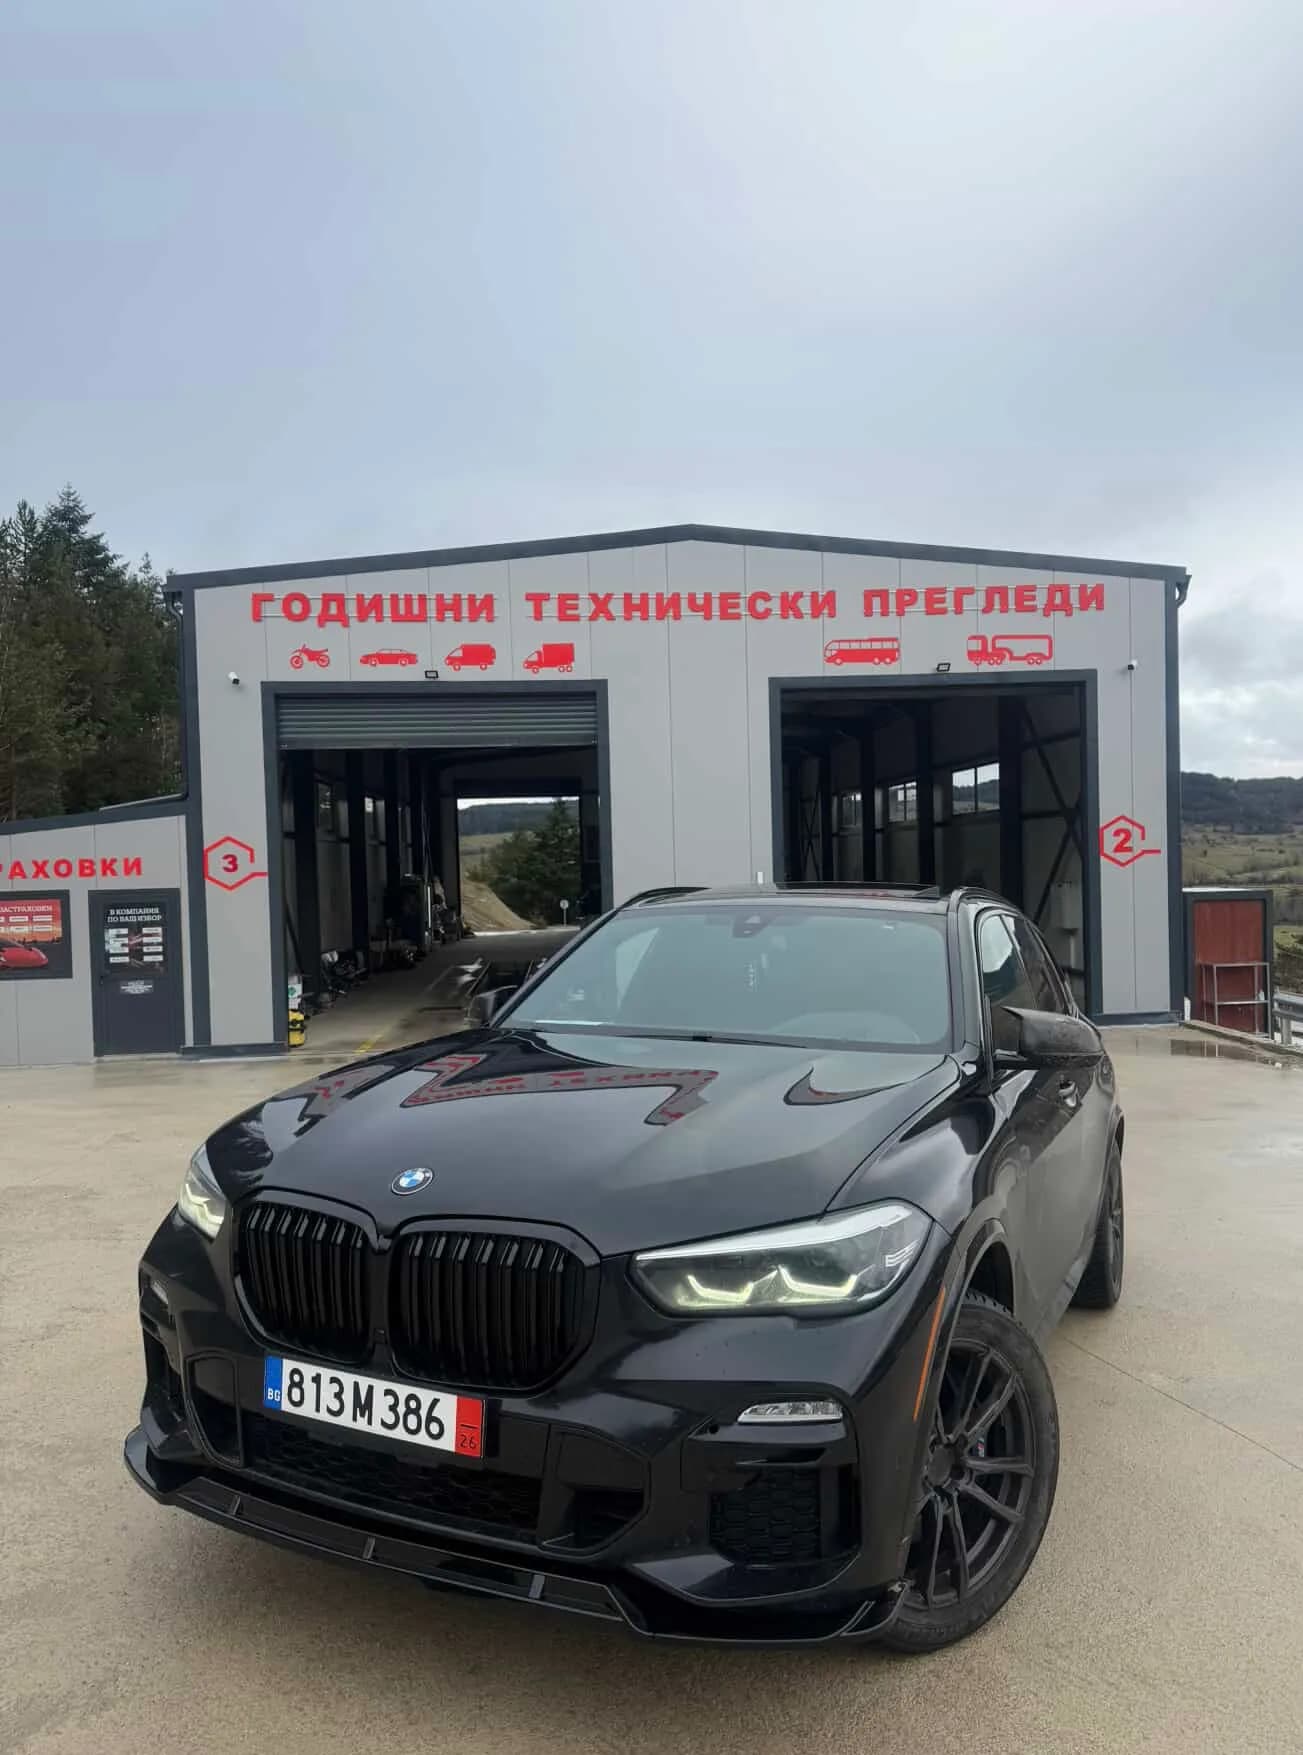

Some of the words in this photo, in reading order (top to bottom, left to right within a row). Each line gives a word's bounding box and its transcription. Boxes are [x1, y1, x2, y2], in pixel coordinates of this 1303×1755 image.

[251, 592, 496, 628] ГОДИШНИ
[525, 591, 837, 622] ТЕХНИЧЕСКИ
[863, 583, 1105, 619] ПРЕГЛЕДИ
[1112, 828, 1133, 853] 2
[222, 854, 239, 873] 3
[267, 1388, 281, 1402] BG
[460, 1434, 477, 1449] 26
